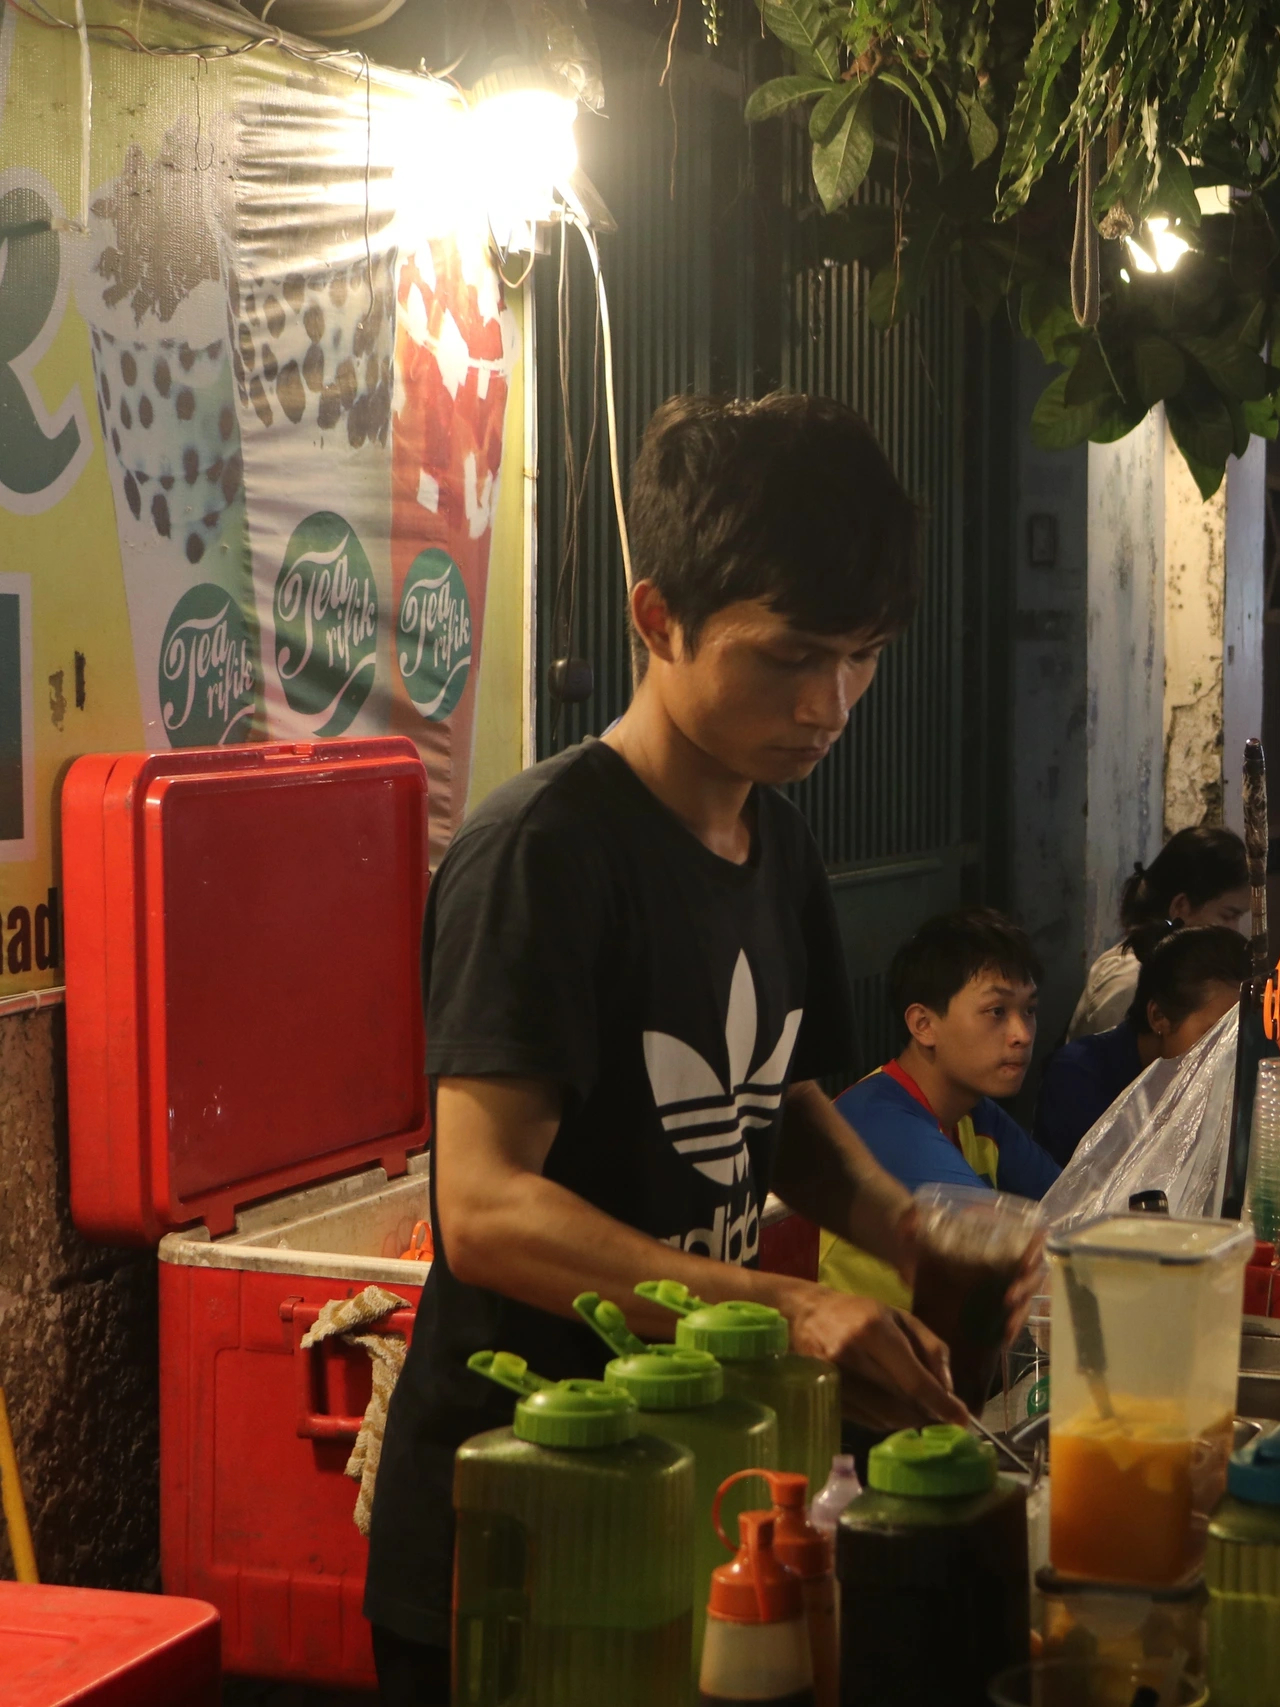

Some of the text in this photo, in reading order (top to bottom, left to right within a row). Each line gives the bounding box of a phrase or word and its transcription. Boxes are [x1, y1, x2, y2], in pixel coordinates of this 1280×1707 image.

[163, 600, 231, 731] Tea
[277, 531, 350, 680] Tea
[400, 563, 453, 678] Tea
